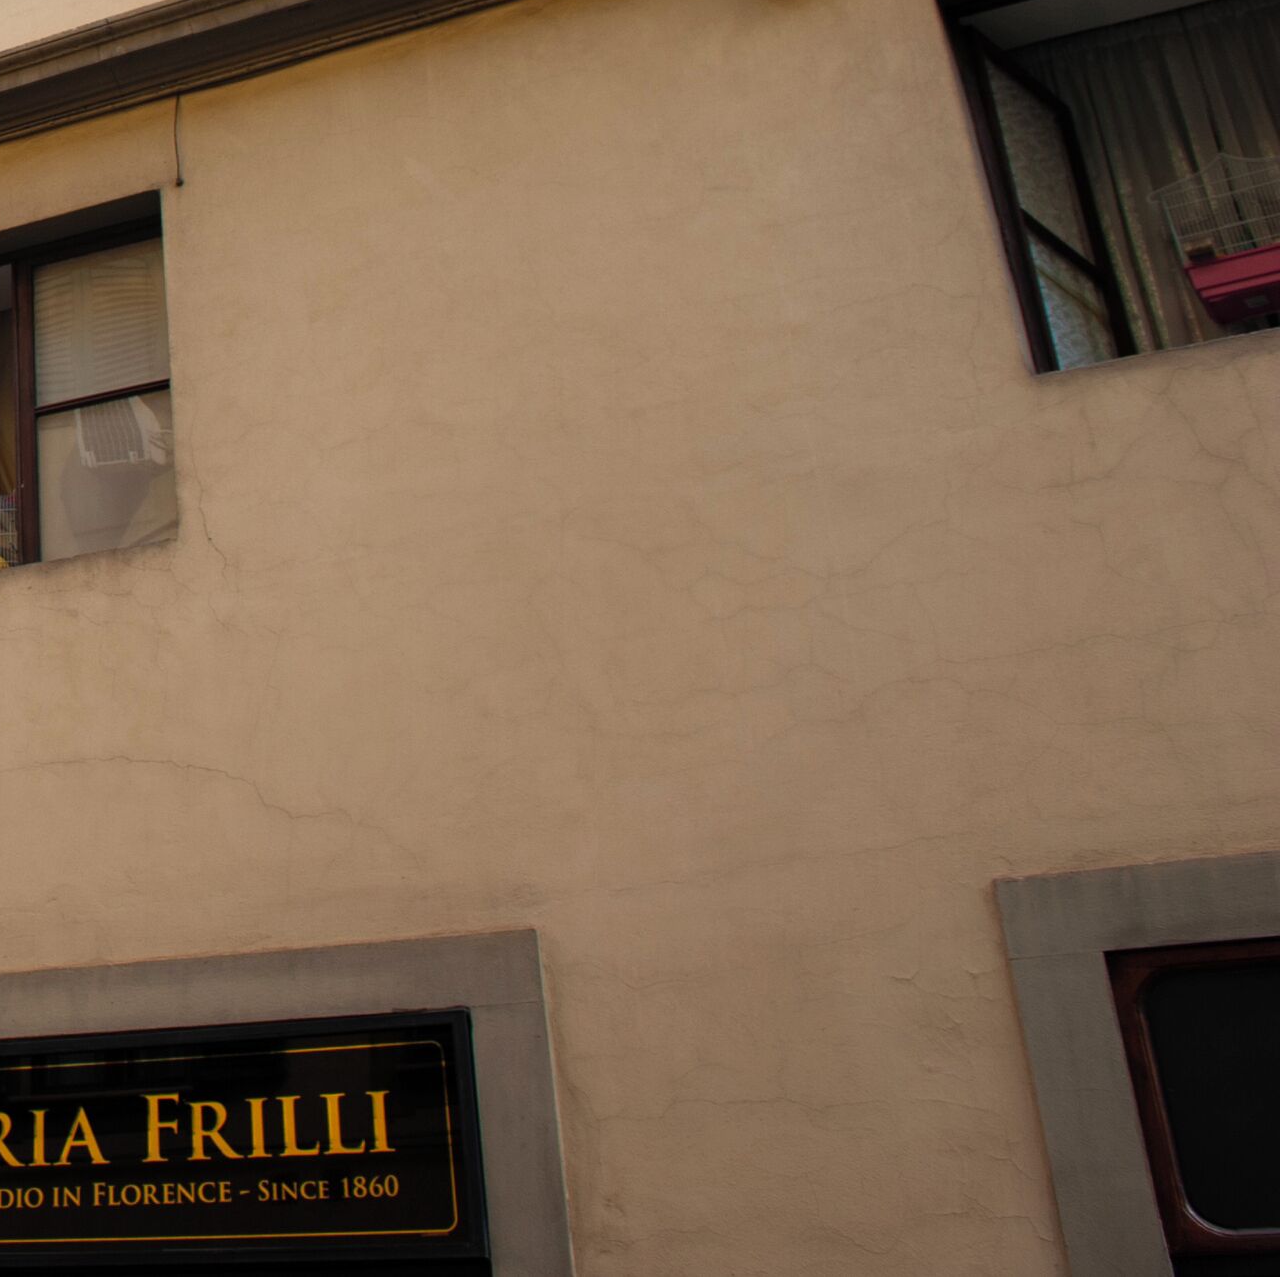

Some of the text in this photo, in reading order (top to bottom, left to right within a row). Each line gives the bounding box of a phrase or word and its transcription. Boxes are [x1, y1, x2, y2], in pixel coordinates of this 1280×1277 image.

[143, 1089, 396, 1164] FRILLI
[52, 1186, 82, 1209] IN
[92, 1181, 232, 1207] FLORENCE
[257, 1179, 330, 1202] SINCE
[341, 1174, 400, 1199] 1860
